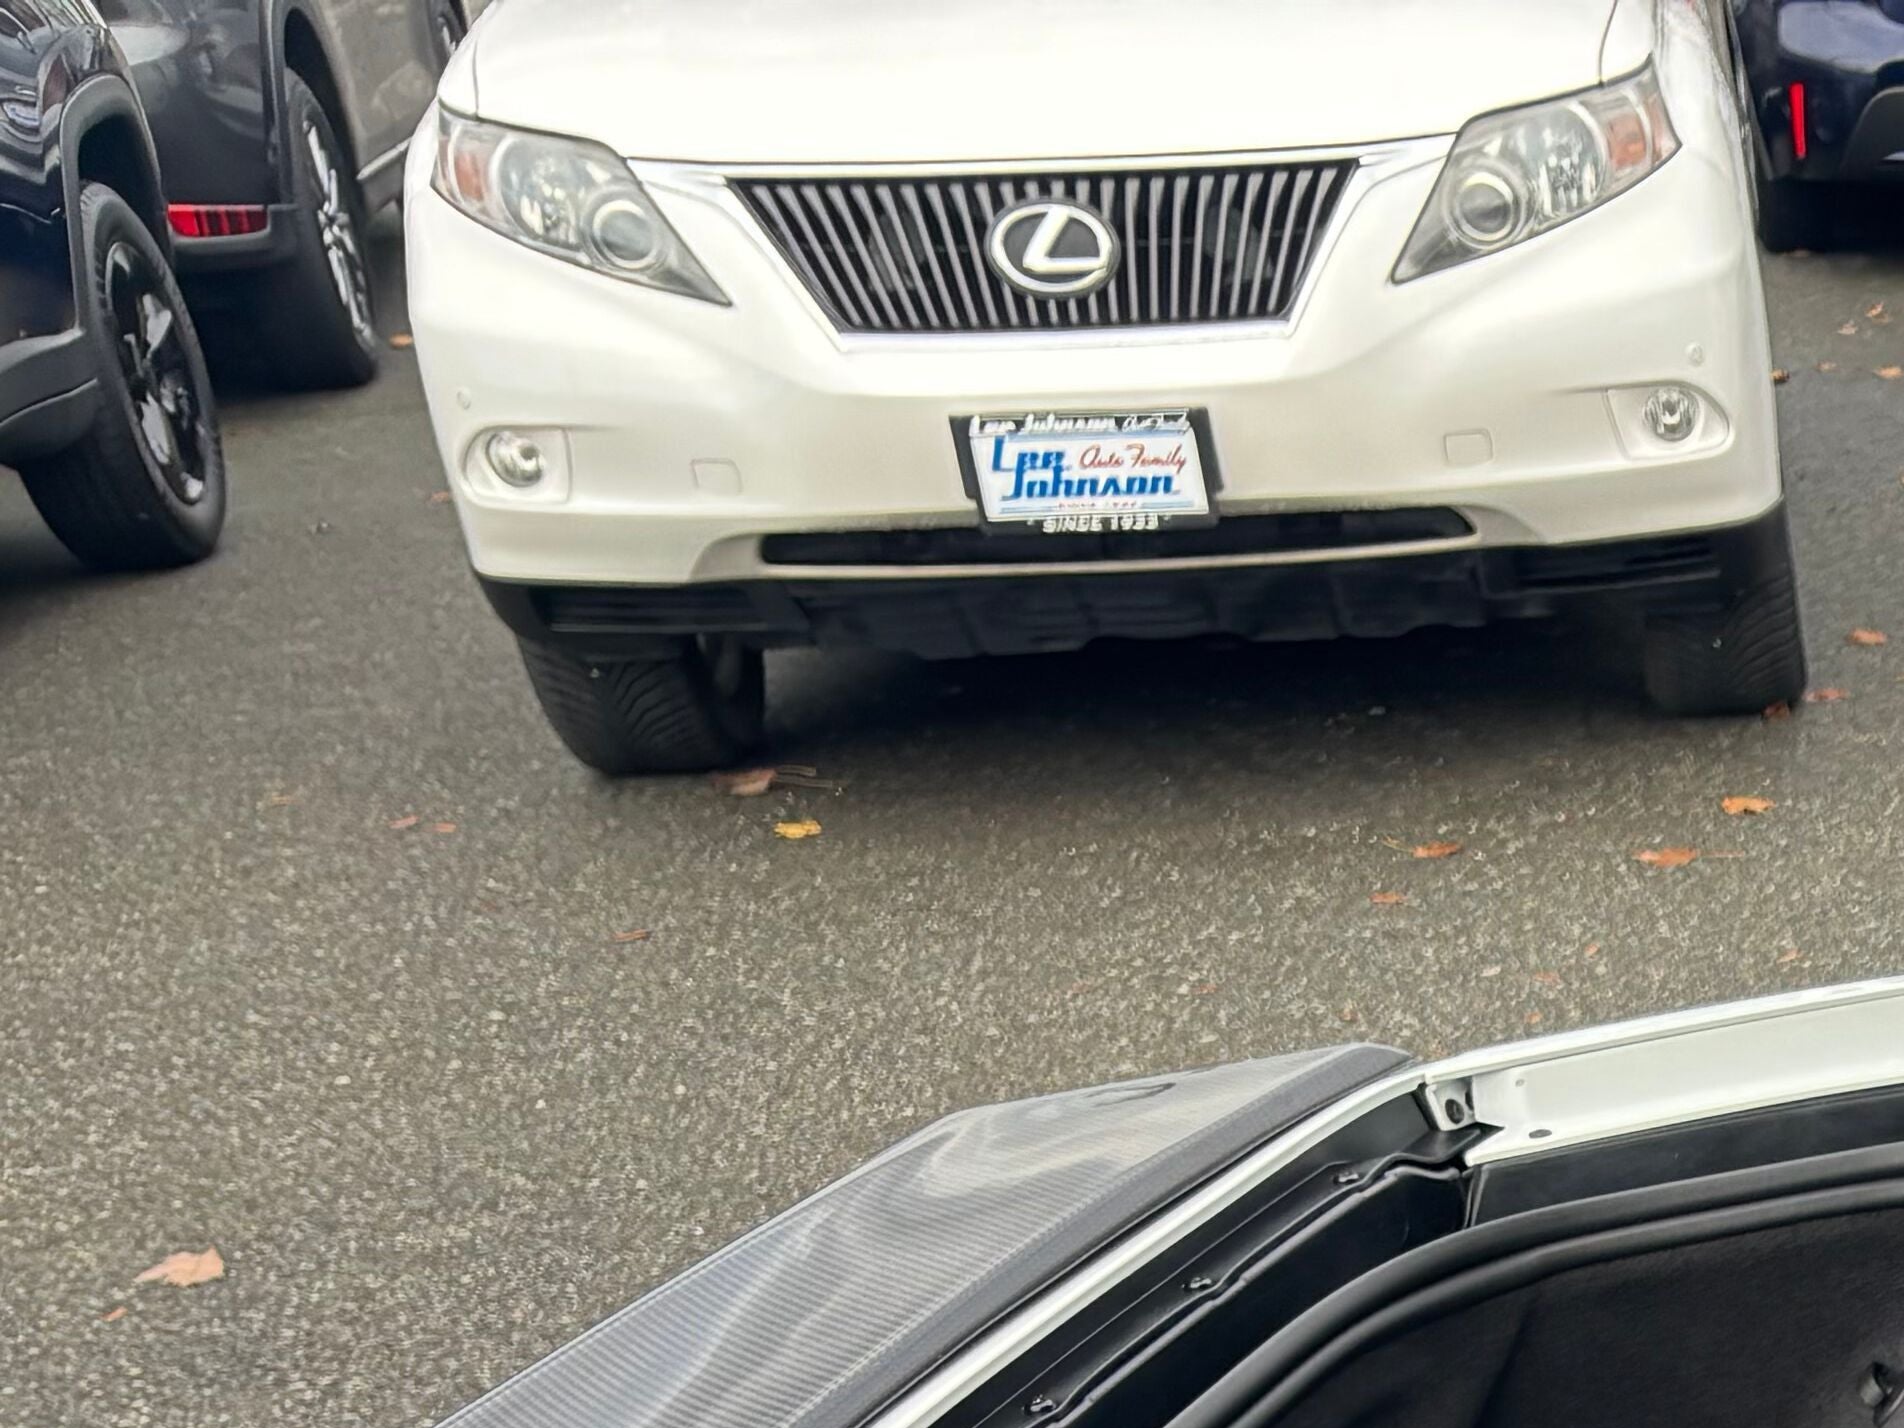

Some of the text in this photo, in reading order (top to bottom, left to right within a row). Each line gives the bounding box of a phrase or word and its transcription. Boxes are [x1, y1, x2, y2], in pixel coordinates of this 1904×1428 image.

[991, 435, 1066, 472] Lee
[1079, 443, 1187, 474] Auto Family
[1000, 463, 1182, 500] Johnson
[1042, 515, 1103, 534] SINCE
